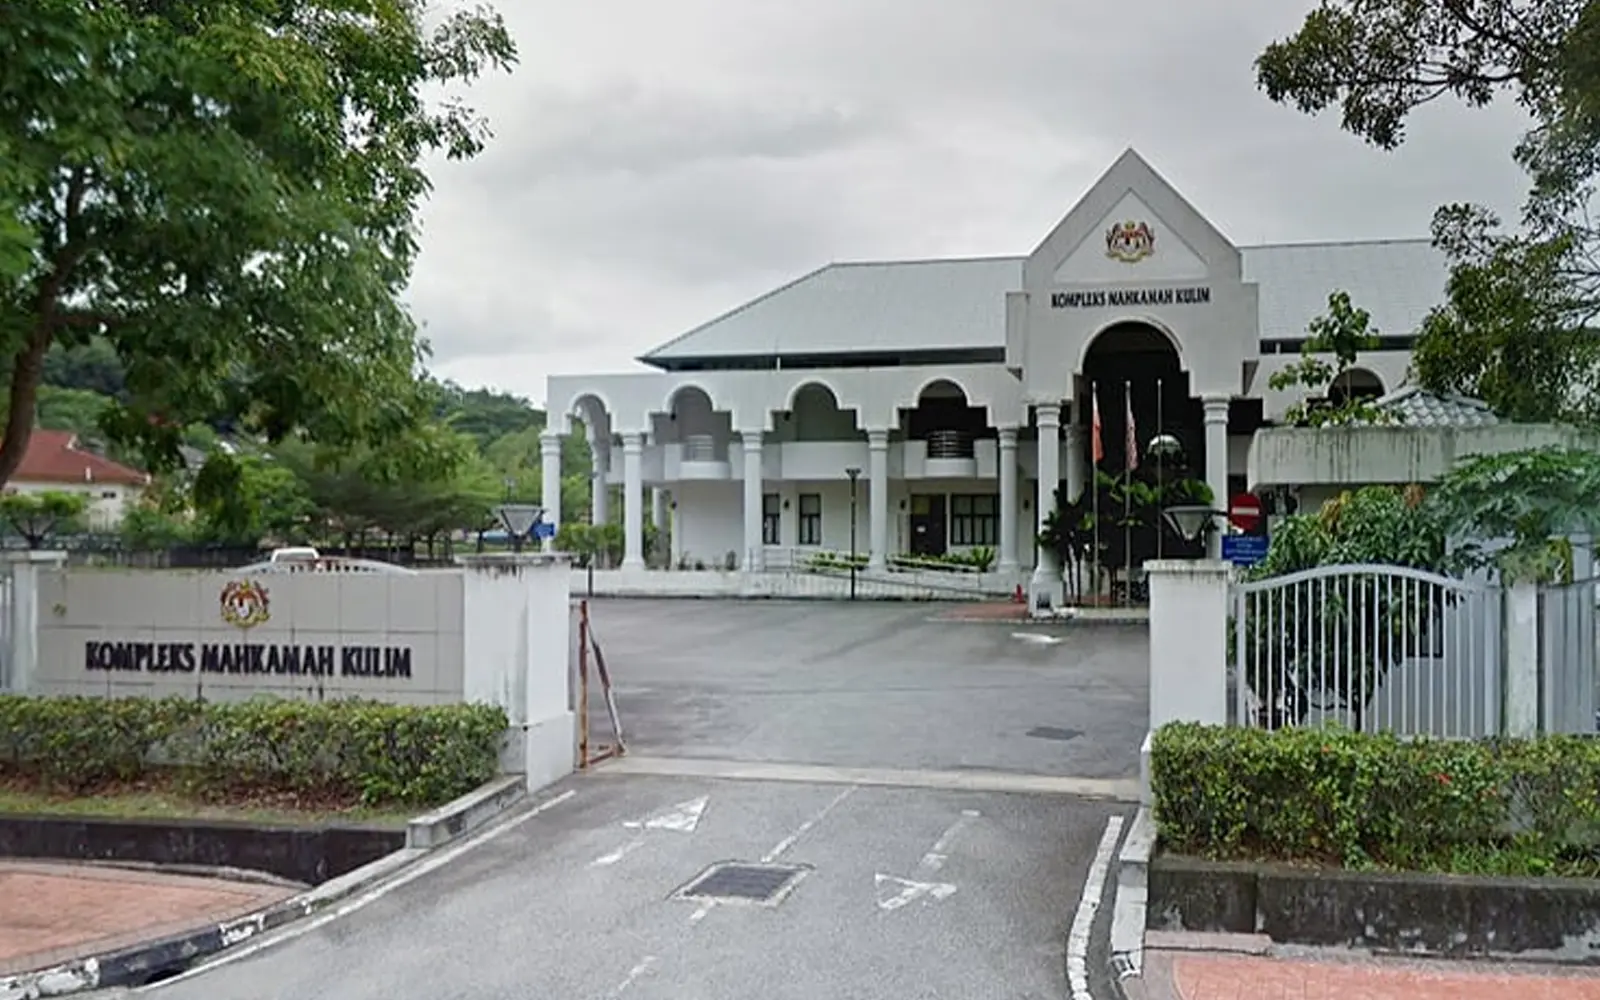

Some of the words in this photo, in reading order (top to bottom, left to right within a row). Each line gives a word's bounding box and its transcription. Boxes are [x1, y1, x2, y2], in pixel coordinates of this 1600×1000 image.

[1051, 292, 1106, 308] KOMPLEKS
[1108, 289, 1173, 306] MAHKAMAH
[1175, 287, 1210, 303] KULIM
[86, 641, 196, 673] KOMPLEKS
[200, 643, 334, 677] MAHKAMAH
[341, 647, 412, 679] KULIM
